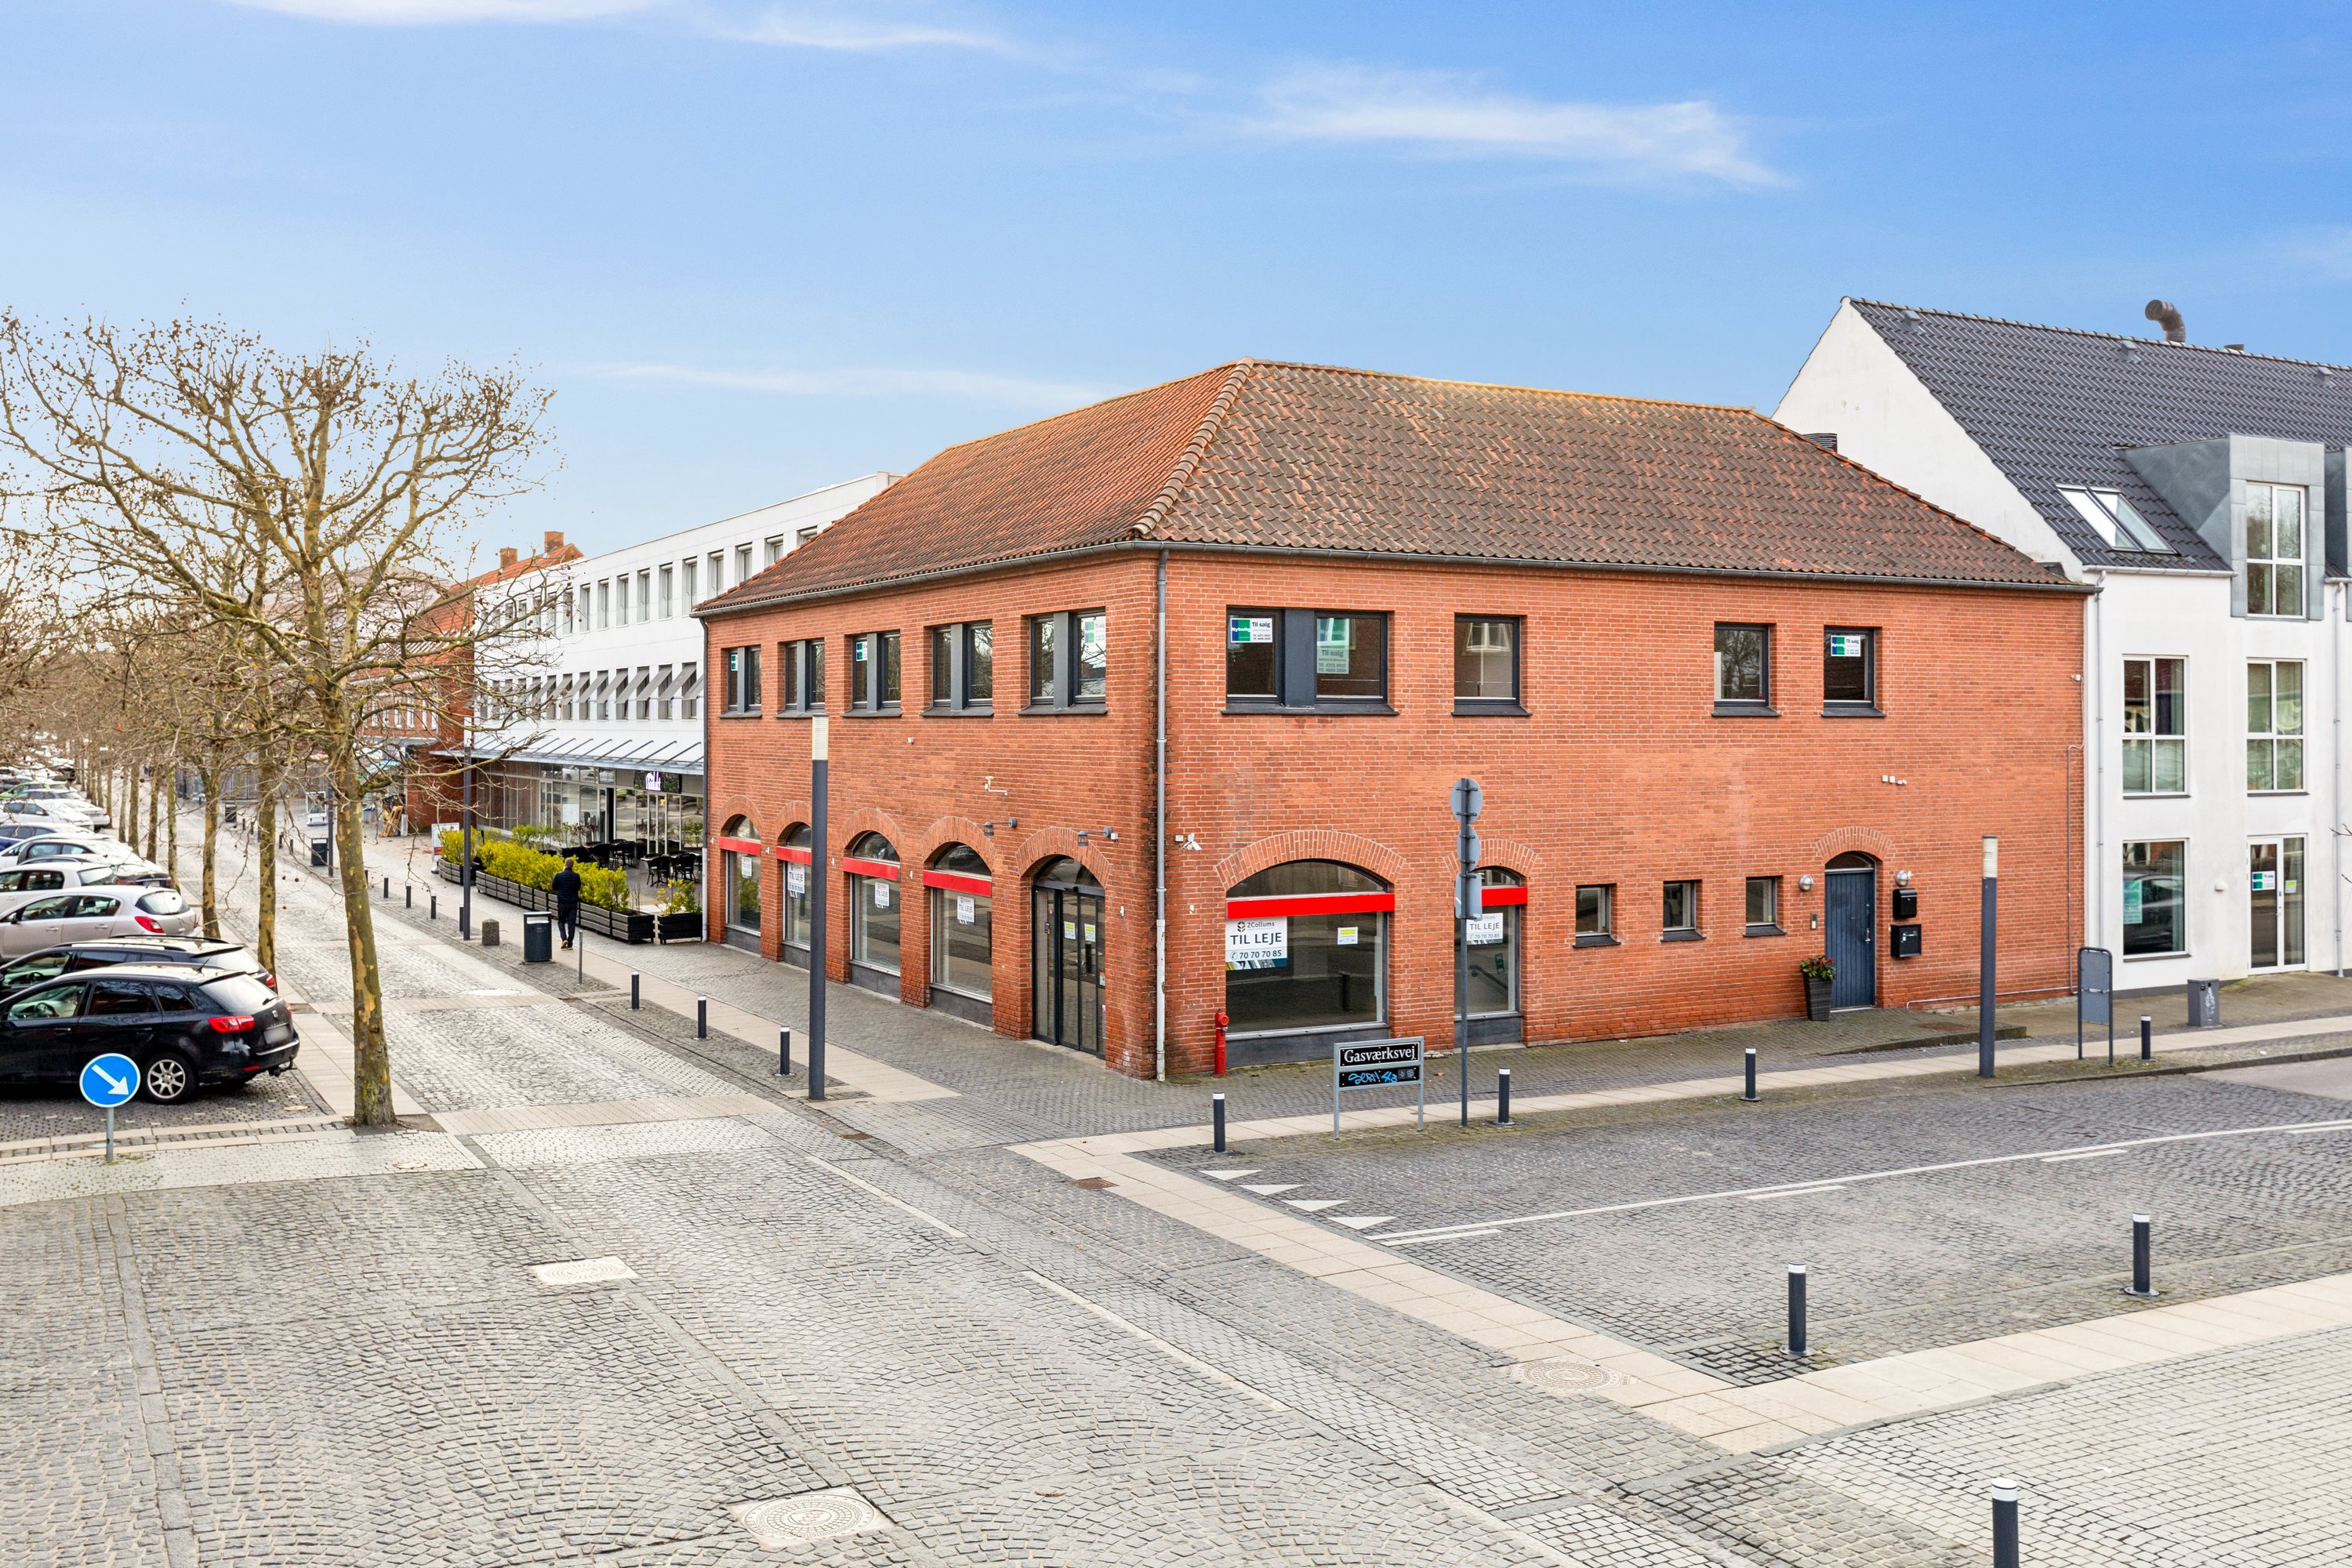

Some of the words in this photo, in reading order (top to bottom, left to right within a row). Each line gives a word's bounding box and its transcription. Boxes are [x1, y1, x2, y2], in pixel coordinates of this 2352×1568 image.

[1230, 935, 1250, 945] TIL
[1255, 933, 1282, 945] LEJE
[1344, 1045, 1415, 1062] Gasværksvej
